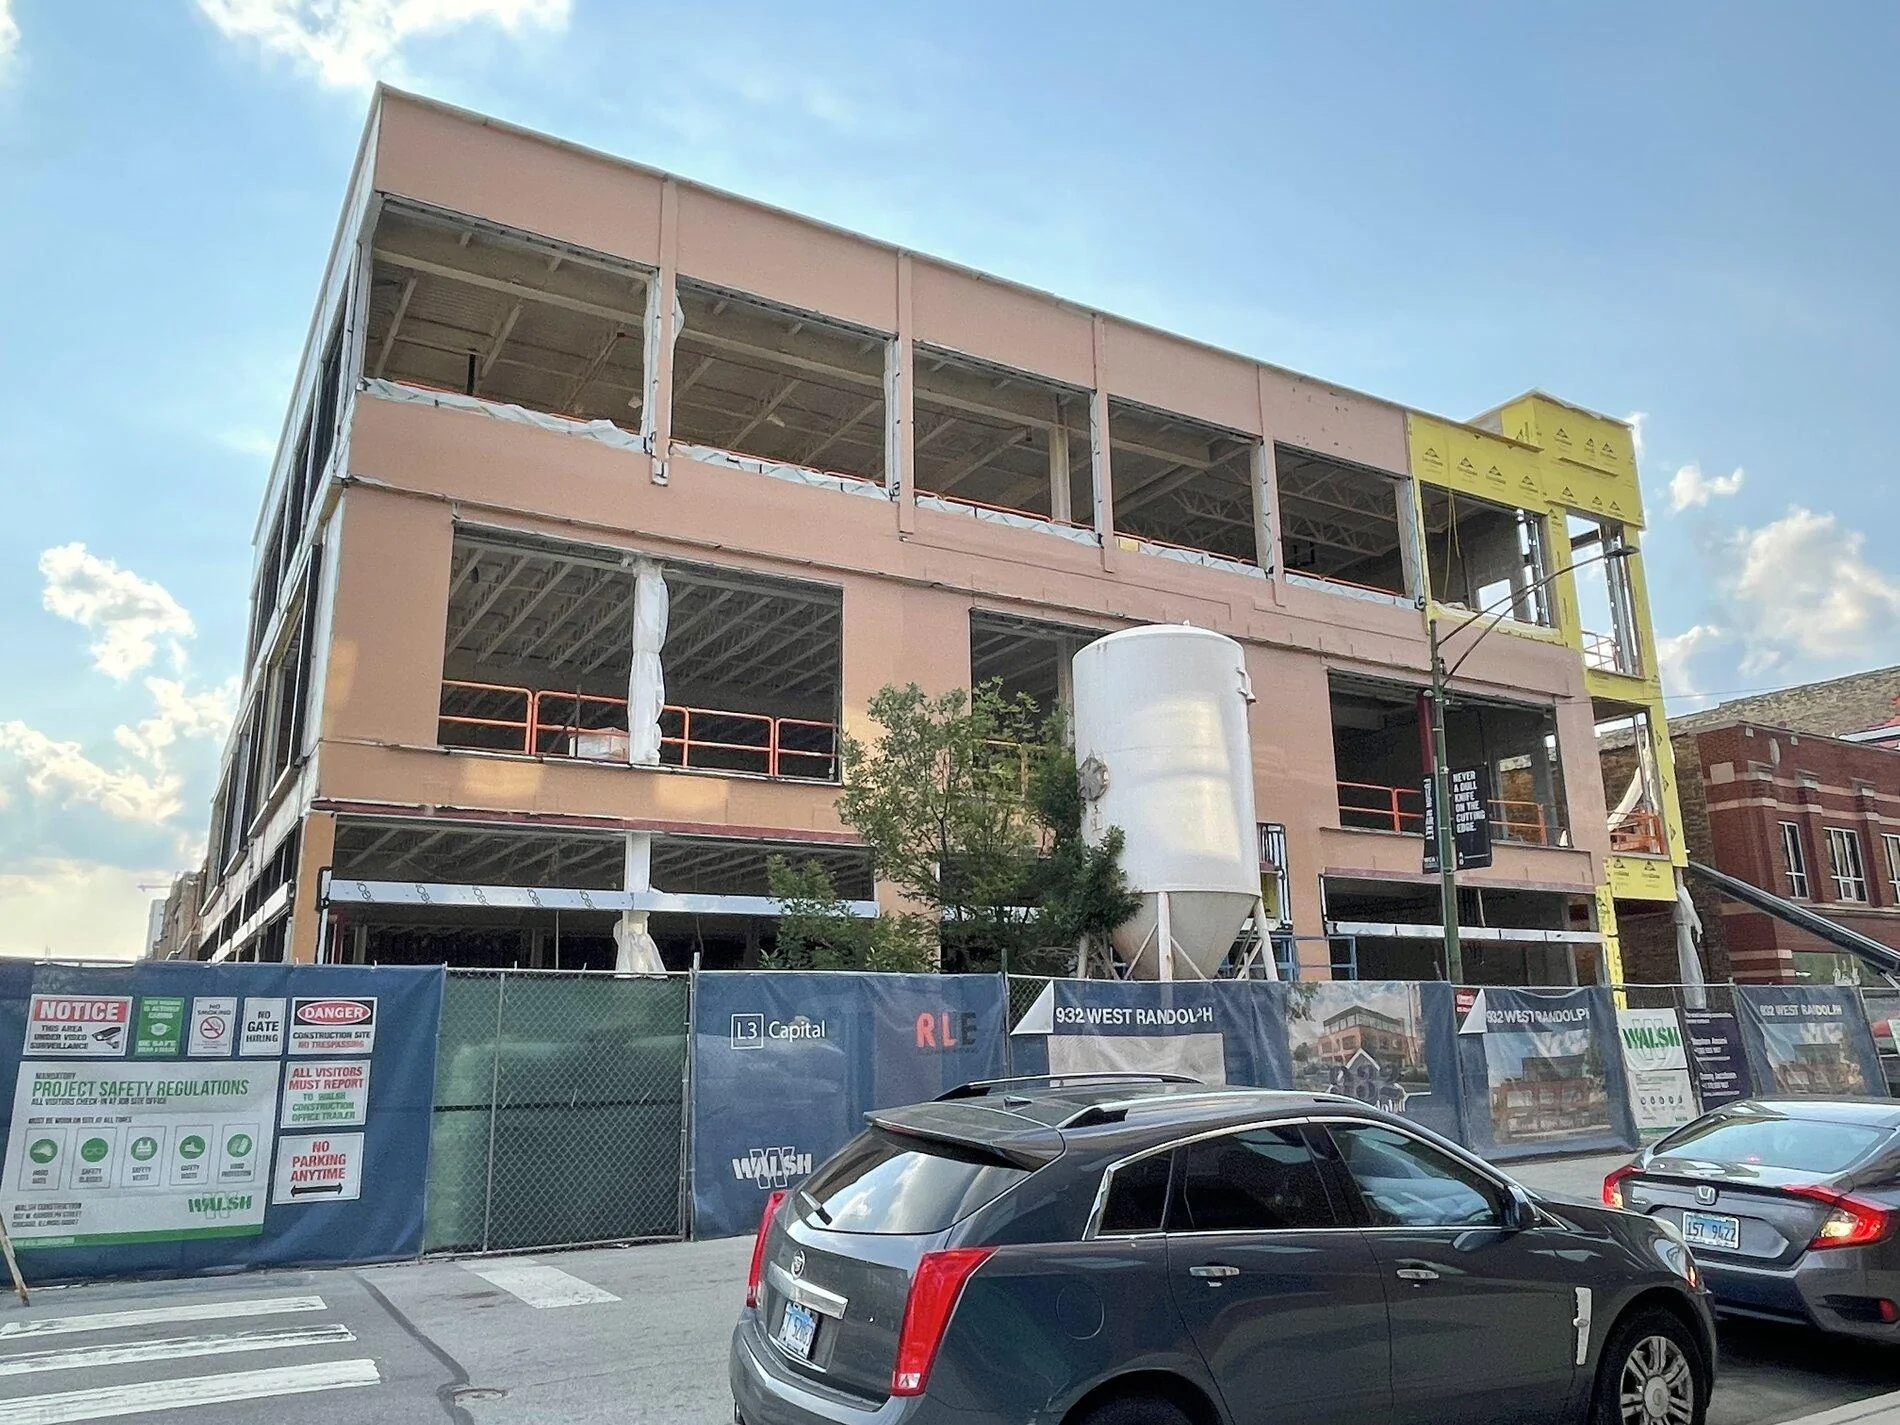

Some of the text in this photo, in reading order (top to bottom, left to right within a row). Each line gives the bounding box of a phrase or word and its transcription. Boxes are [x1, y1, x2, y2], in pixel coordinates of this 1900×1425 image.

[1452, 770, 1476, 782] NEVER
[1454, 781, 1478, 792] A DULL
[1454, 791, 1475, 802] KNIFE
[1455, 800, 1480, 812] ON THE
[1456, 810, 1486, 822] CUTTING
[39, 1000, 120, 1020] NOTICE
[258, 1011, 271, 1019] NO
[304, 1007, 364, 1019] DANGER
[1056, 1007, 1085, 1024] 932
[1086, 1008, 1132, 1024] WEST
[1760, 1004, 1842, 1016] 932 WEST RANDOLPH
[1486, 1010, 1504, 1024] 932
[1504, 1010, 1535, 1023] WEST
[247, 1021, 279, 1032] GATE
[737, 1020, 825, 1042] L3 Capital
[914, 1012, 977, 1048] RLE
[246, 1034, 278, 1042] HIRING
[354, 1031, 371, 1039] SITE
[1622, 1026, 1681, 1049] WALSH
[30, 1042, 88, 1050] SURVEILLANCE
[312, 1040, 364, 1048] TRESPASSING
[292, 1066, 363, 1078] ALL VISITORS
[32, 1079, 249, 1097] PROJECT SAFETY REGULATIONS
[288, 1078, 363, 1090] MUST REPORT
[303, 1093, 314, 1101] TO
[292, 1102, 355, 1112] CONSTRUCTION
[292, 1111, 355, 1121] OFFICE TRAILER
[312, 1141, 329, 1152] NO
[292, 1154, 346, 1167] PARKING
[732, 1154, 812, 1179] WALSH
[290, 1168, 346, 1182] ANYTIME
[188, 1194, 252, 1213] WALSH
